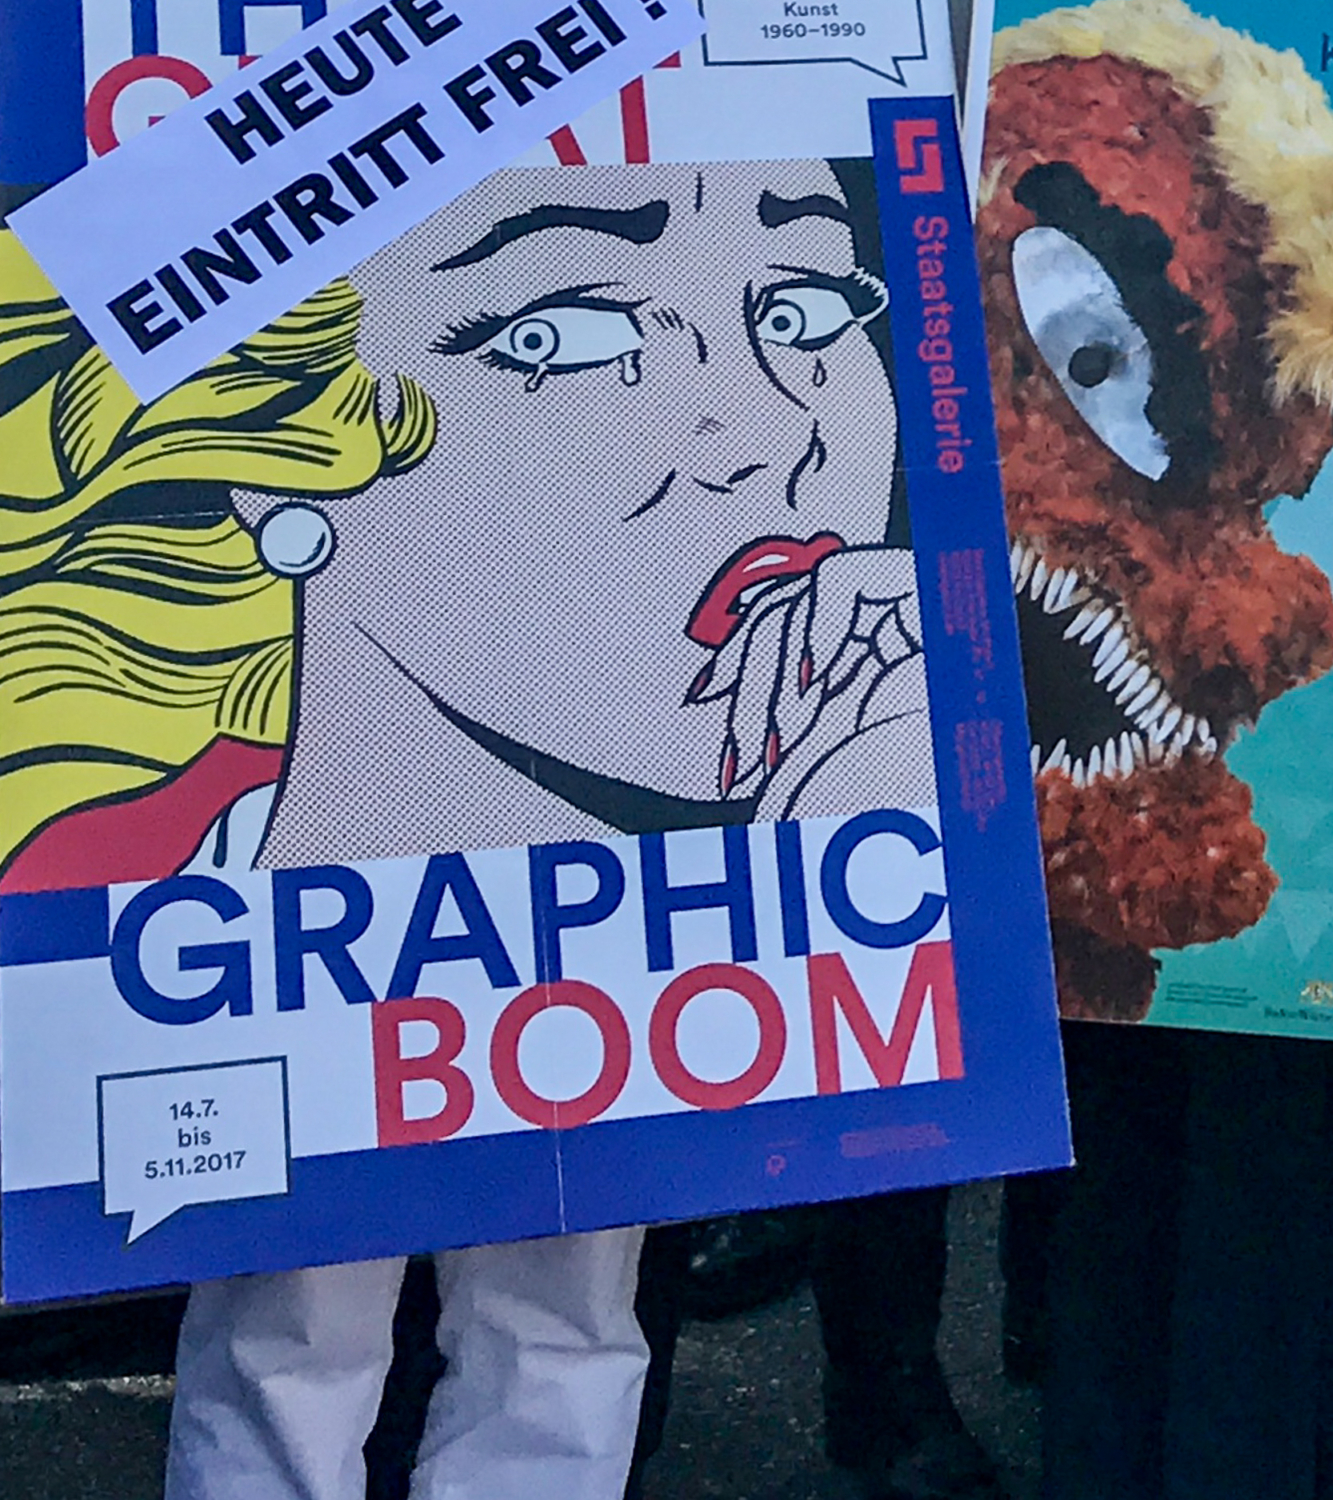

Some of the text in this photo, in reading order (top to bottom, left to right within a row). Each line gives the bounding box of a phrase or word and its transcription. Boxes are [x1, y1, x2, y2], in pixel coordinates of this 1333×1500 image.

[784, 2, 839, 17] Kunst
[760, 22, 867, 39] 1960–1990
[105, 102, 446, 355] EINTRITT
[912, 216, 972, 473] Staatsgalerie
[110, 807, 950, 1026] GRAPHIC
[370, 940, 965, 1148] BOOM
[168, 1098, 219, 1121] 14.7.
[177, 1126, 212, 1149] bis
[144, 1151, 247, 1180] 5.11.2017
